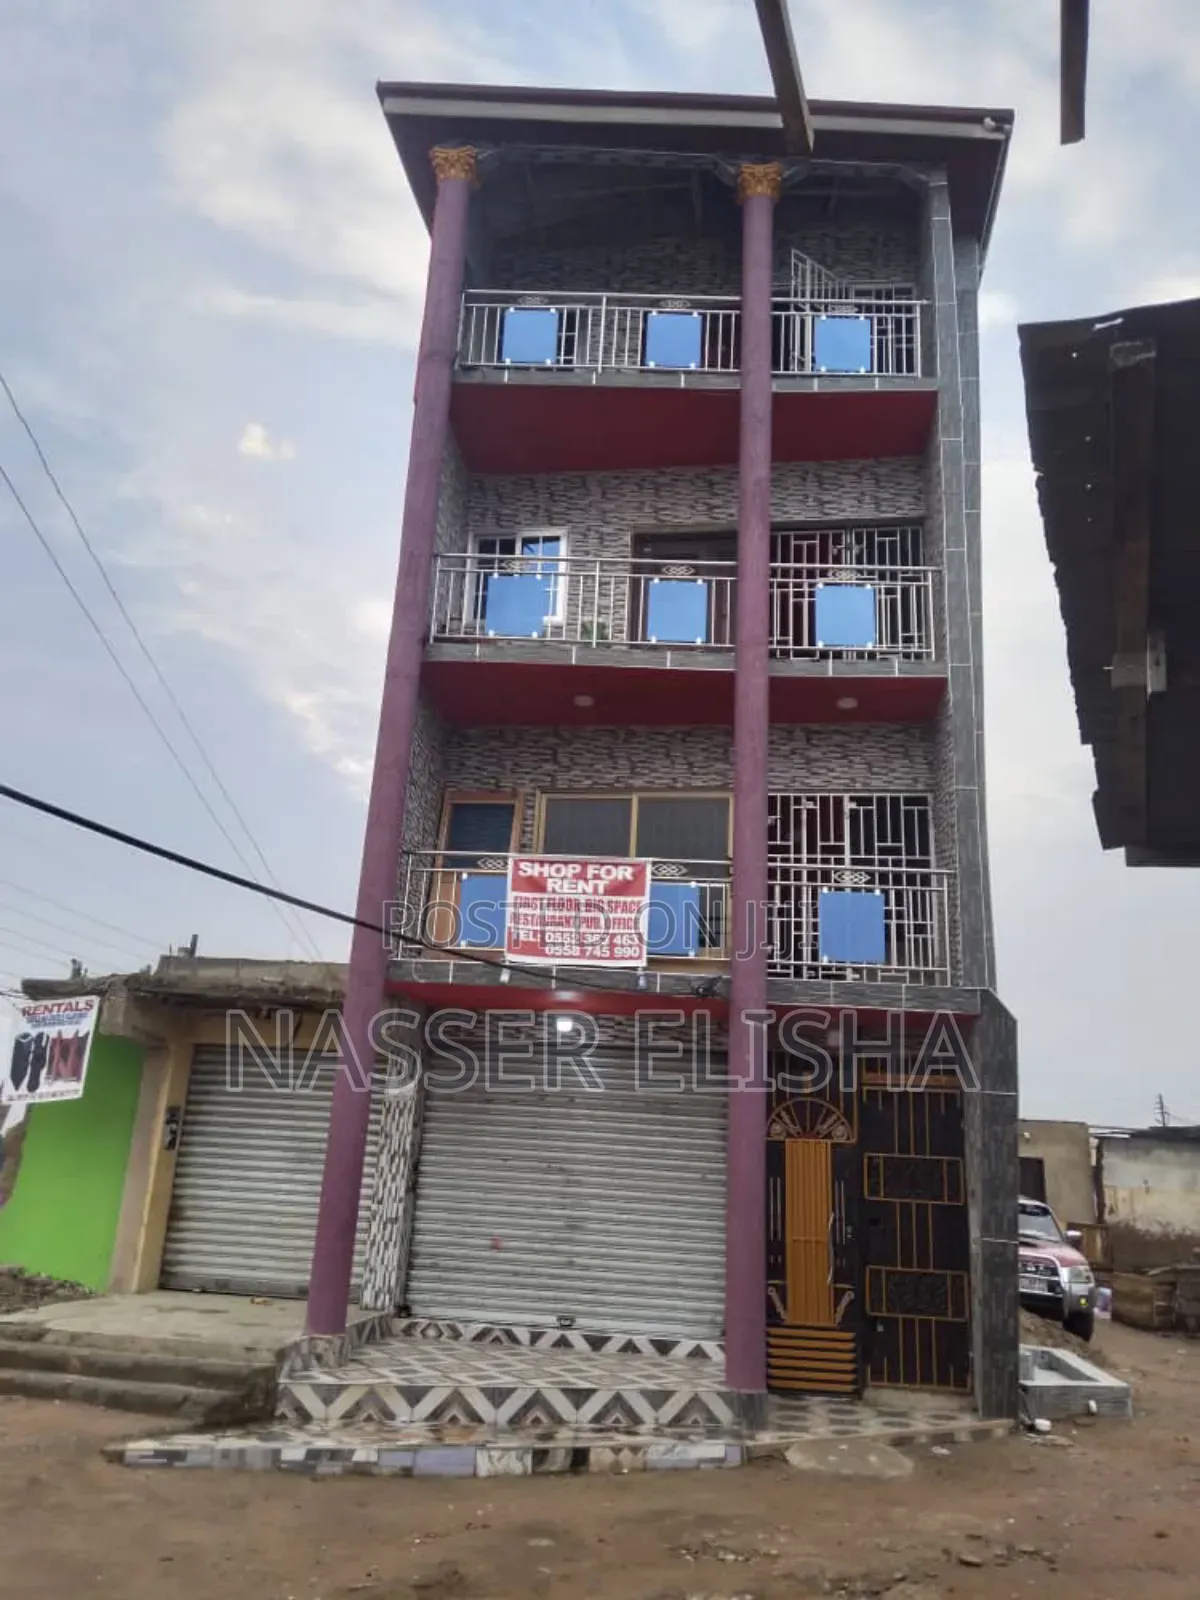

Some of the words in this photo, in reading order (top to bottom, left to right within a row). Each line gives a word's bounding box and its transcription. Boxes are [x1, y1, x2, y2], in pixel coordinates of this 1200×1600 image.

[518, 861, 581, 878] SHOP
[587, 864, 634, 881] FOR
[546, 878, 610, 895] RENT
[22, 1000, 93, 1017] RENTALS
